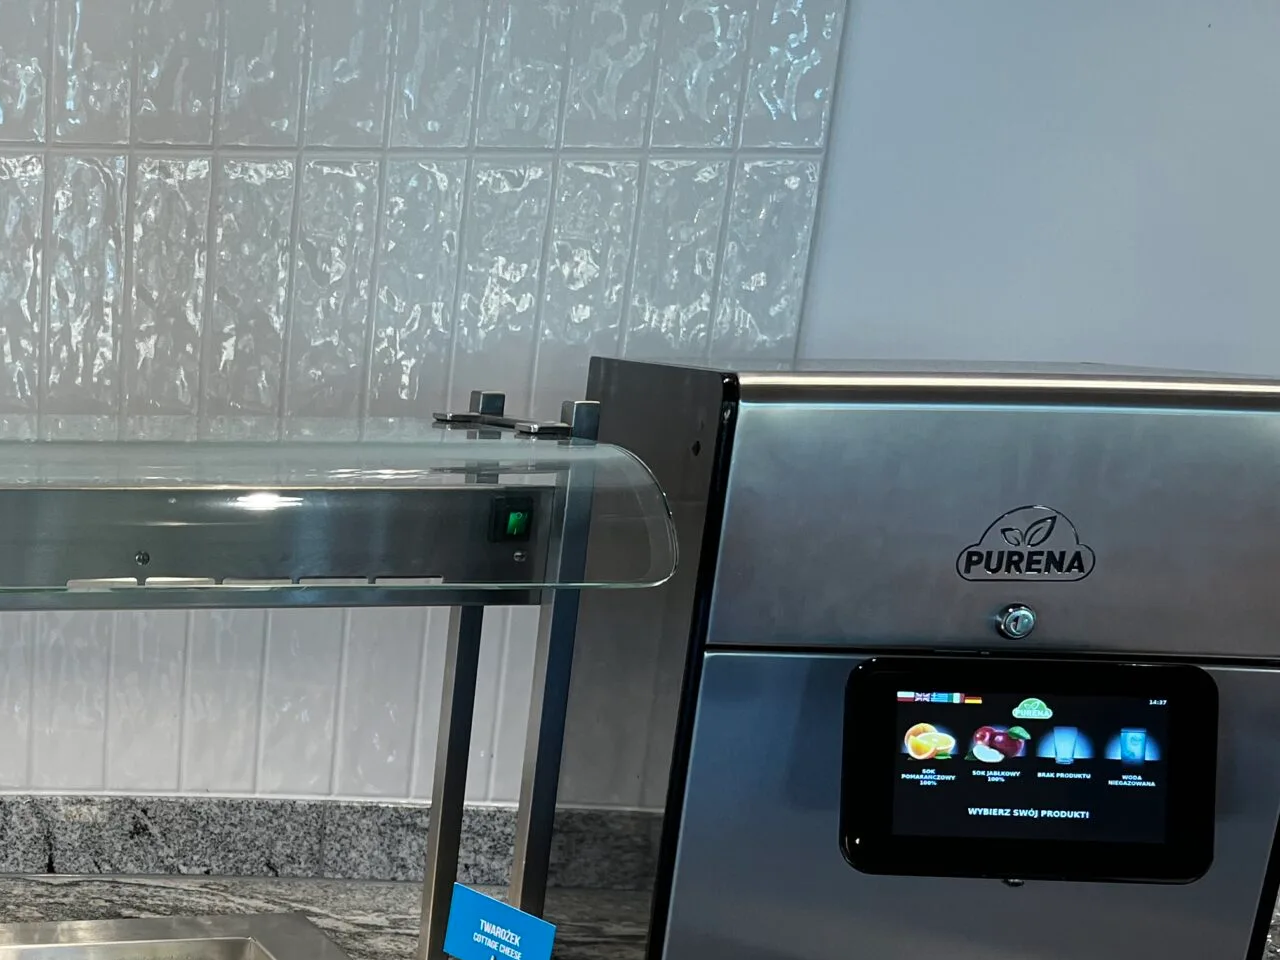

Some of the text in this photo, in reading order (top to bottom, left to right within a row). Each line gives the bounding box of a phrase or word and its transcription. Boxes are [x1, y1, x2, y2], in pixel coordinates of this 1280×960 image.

[963, 550, 1086, 574] PURENA
[967, 807, 1011, 817] WYBIERZ
[1013, 807, 1039, 819] SWÓJ
[473, 932, 522, 960] COTTAGE CHEESE
[480, 919, 521, 947] TWAROŻEK
